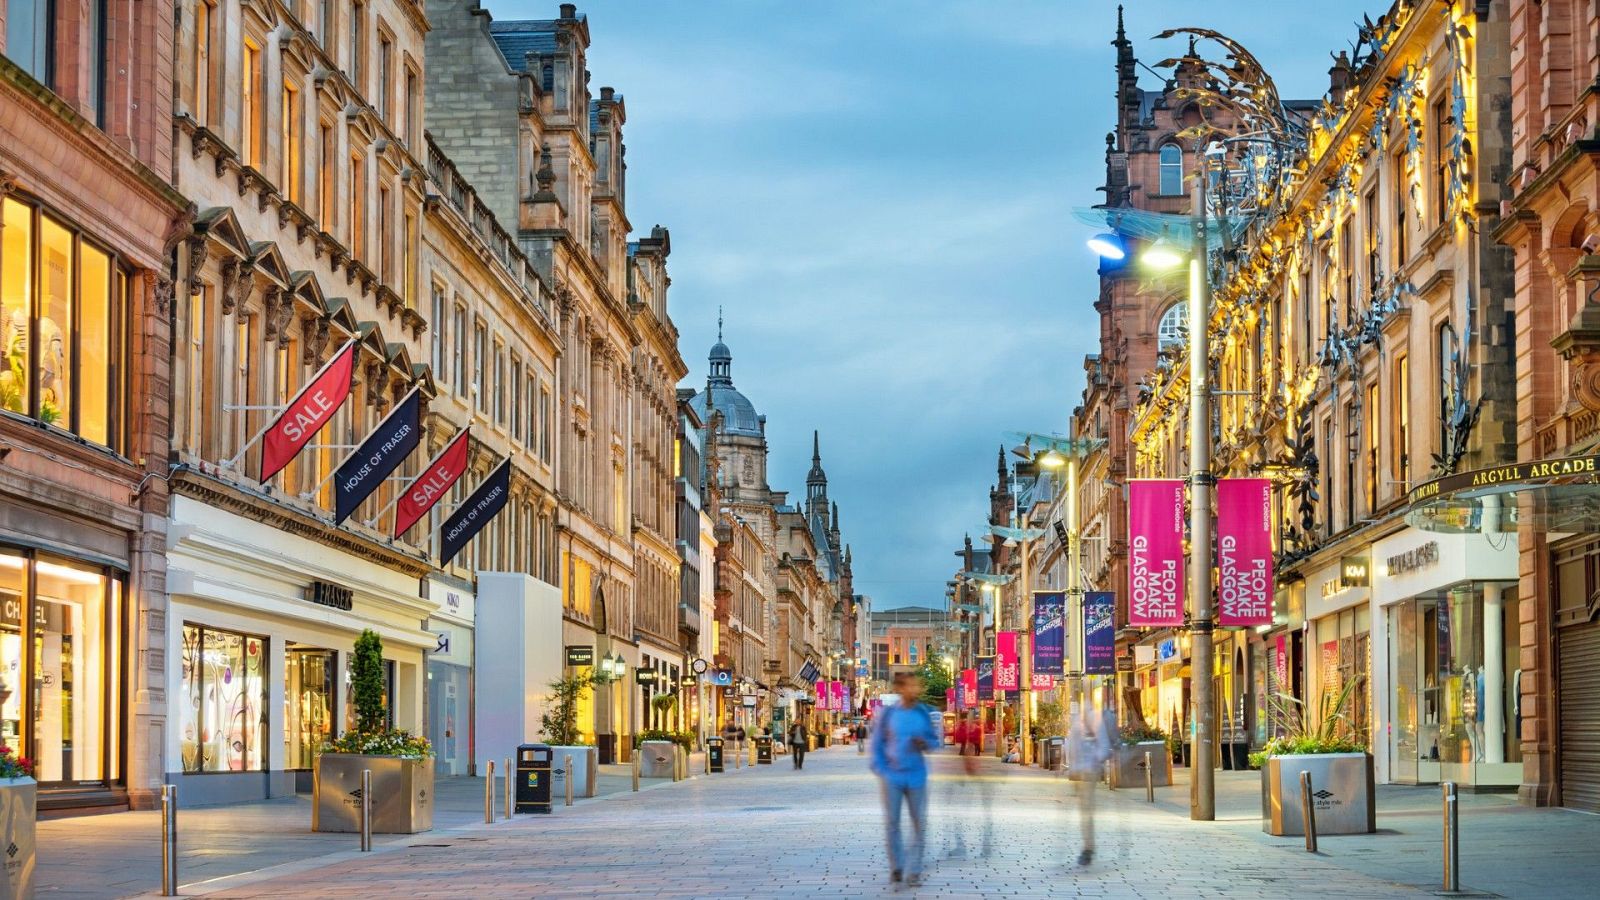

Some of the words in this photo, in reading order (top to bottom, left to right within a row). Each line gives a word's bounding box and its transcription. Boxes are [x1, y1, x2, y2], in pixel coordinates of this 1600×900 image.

[283, 390, 333, 442] SALE
[343, 463, 373, 493] HOUSE
[370, 453, 383, 466] OF
[381, 424, 412, 455] FRASER
[1473, 467, 1521, 485] ARGYLL
[1530, 458, 1595, 478] ARCADE
[413, 465, 453, 507] SALE
[1416, 482, 1440, 500] ARCADE
[447, 518, 470, 542] HOUSE
[467, 508, 478, 520] OF
[477, 485, 503, 511] FRASER
[1133, 535, 1148, 618] GLASGOW
[1162, 560, 1176, 618] PEOPLE
[1221, 535, 1237, 617] GLASGOW
[1252, 559, 1266, 617] PEOPLE
[1345, 565, 1365, 577] KM
[5, 600, 47, 624] CHEL
[1148, 572, 1162, 618] MAKE
[1237, 572, 1251, 617] MAKE
[1036, 615, 1063, 636] GLASGOW
[1086, 615, 1112, 636] GLASGOW
